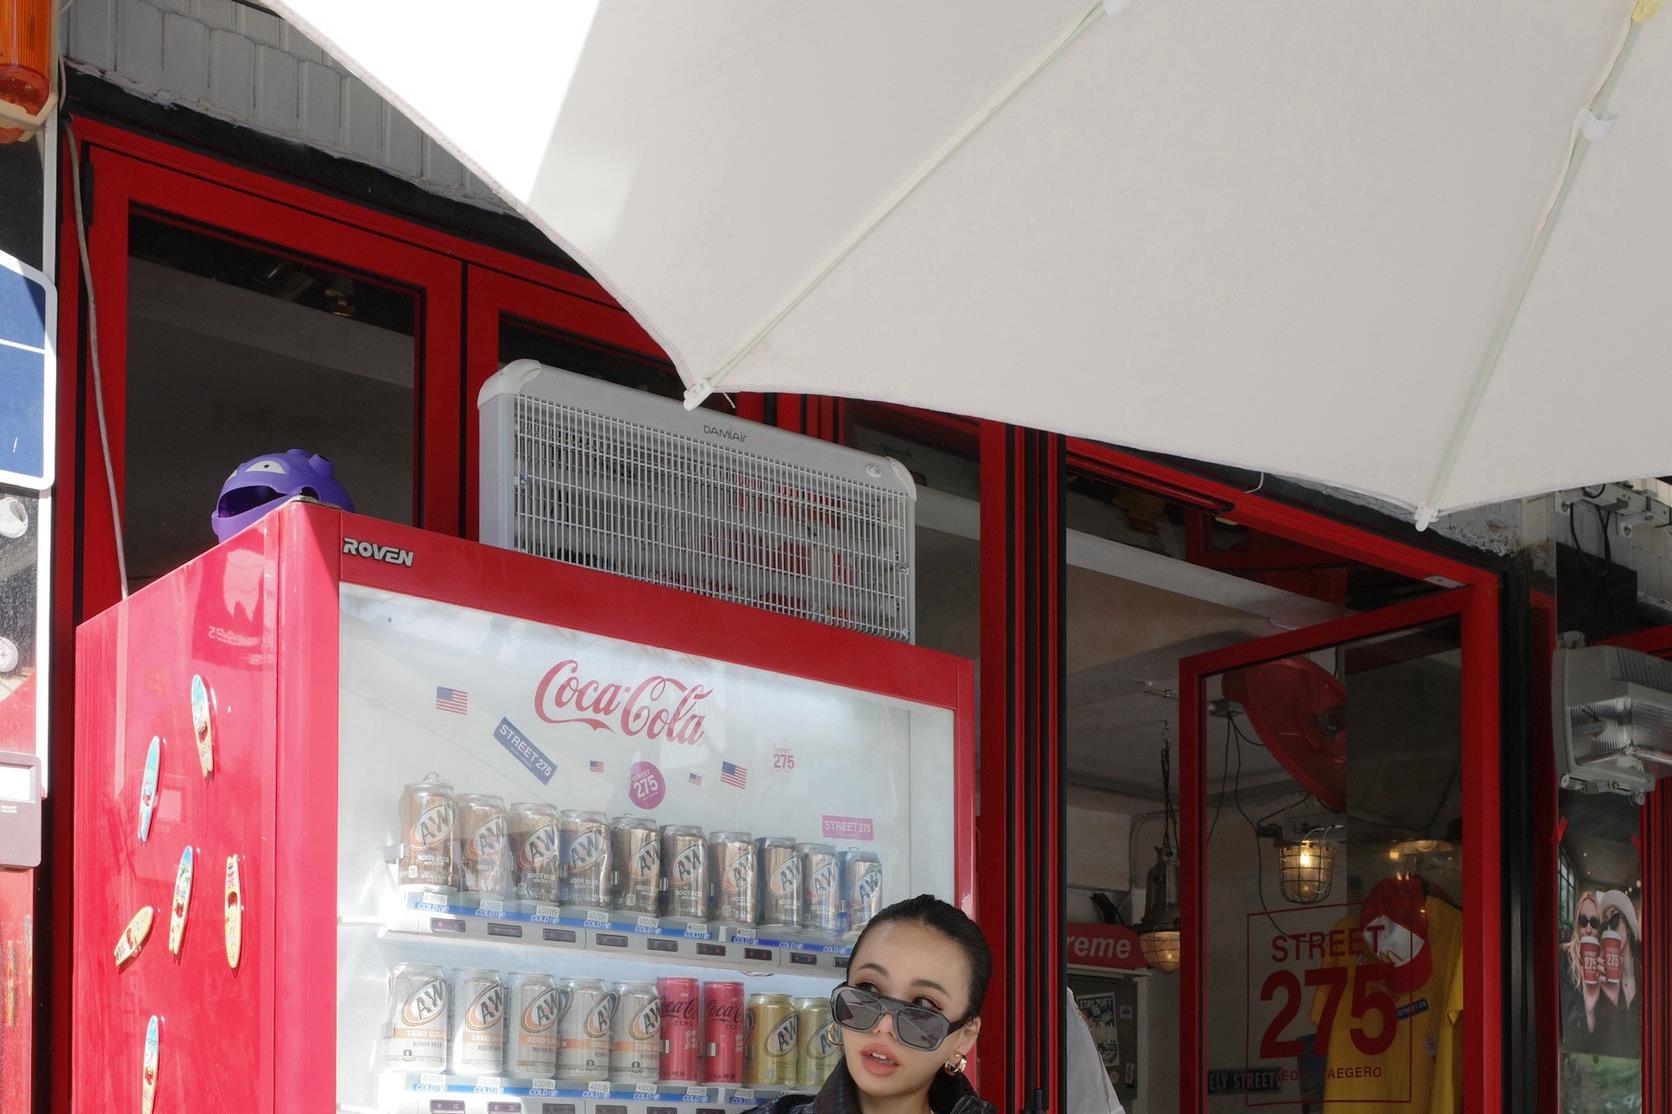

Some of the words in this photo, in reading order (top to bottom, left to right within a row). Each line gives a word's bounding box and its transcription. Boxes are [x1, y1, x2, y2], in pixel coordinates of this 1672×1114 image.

[342, 537, 414, 567] ROVEN
[534, 659, 714, 746] Coca-Cola
[499, 723, 538, 763] STREET
[536, 757, 553, 778] 275
[773, 753, 795, 769] 275
[633, 774, 659, 800] 275
[824, 820, 857, 832] STREET
[1066, 936, 1131, 959] reme
[1272, 925, 1386, 963] STREET
[1260, 964, 1398, 1060] 275
[1232, 1071, 1276, 1089] STREET
